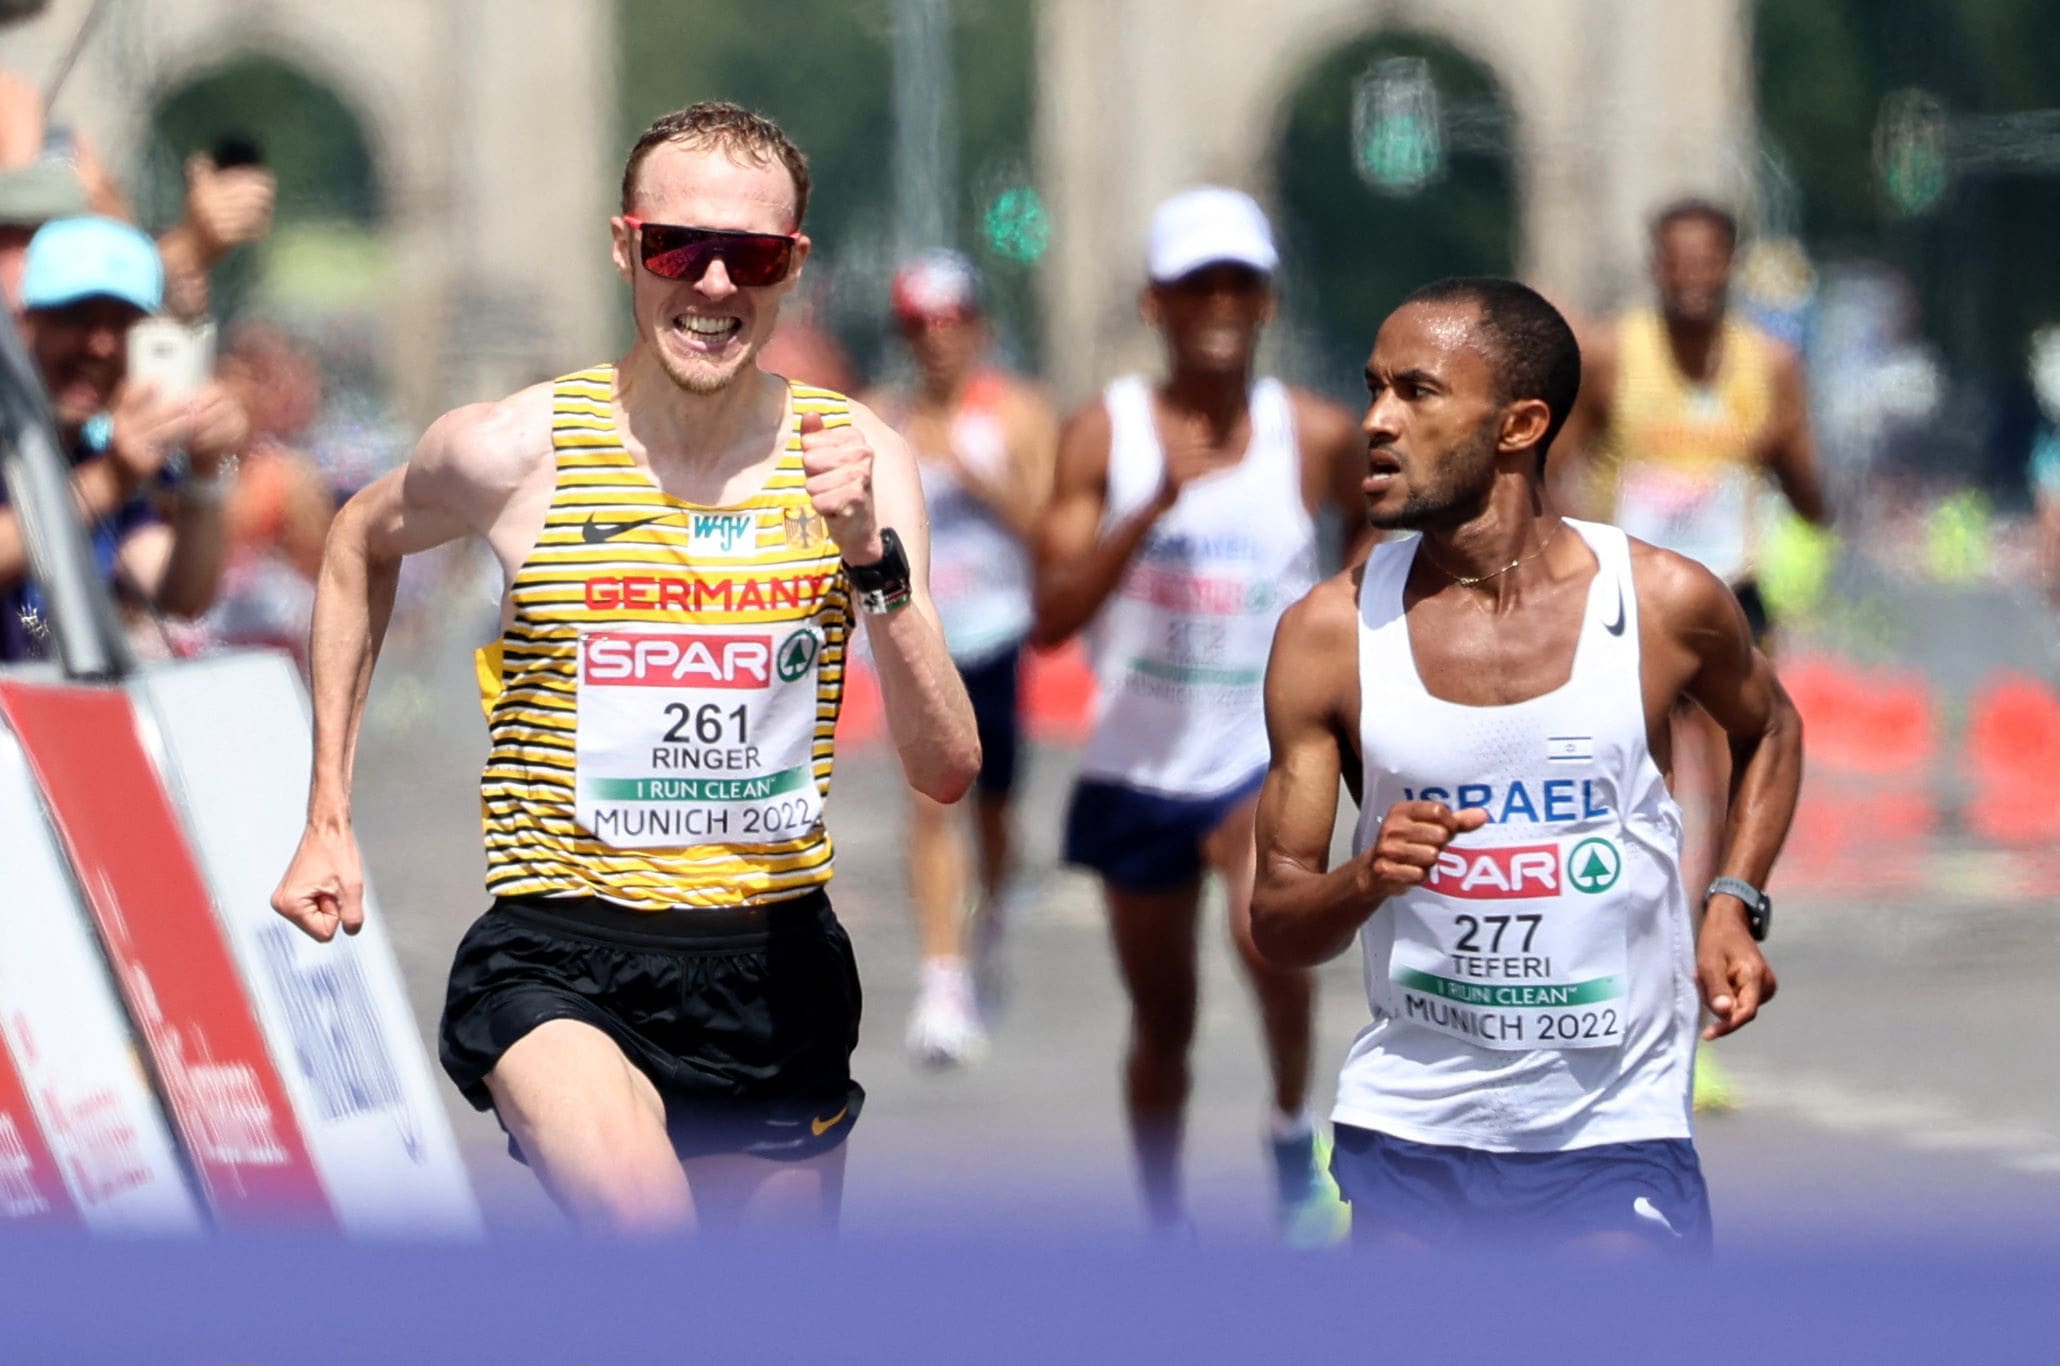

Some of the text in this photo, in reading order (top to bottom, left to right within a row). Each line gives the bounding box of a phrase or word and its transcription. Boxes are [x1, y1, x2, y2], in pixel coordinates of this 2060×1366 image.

[585, 573, 828, 612] GERMANY
[588, 639, 769, 681] SPAR
[663, 702, 748, 744] 261
[652, 746, 761, 770] RINGER
[637, 782, 644, 798] I
[651, 781, 697, 798] RUN
[595, 798, 812, 836] MUNICH 2022
[1429, 851, 1557, 891] PAR
[1454, 914, 1542, 952] 277
[1450, 954, 1550, 978] TEFERI
[1448, 982, 1491, 1003] RUN
[1405, 994, 1619, 1040] MUNICH 2022
